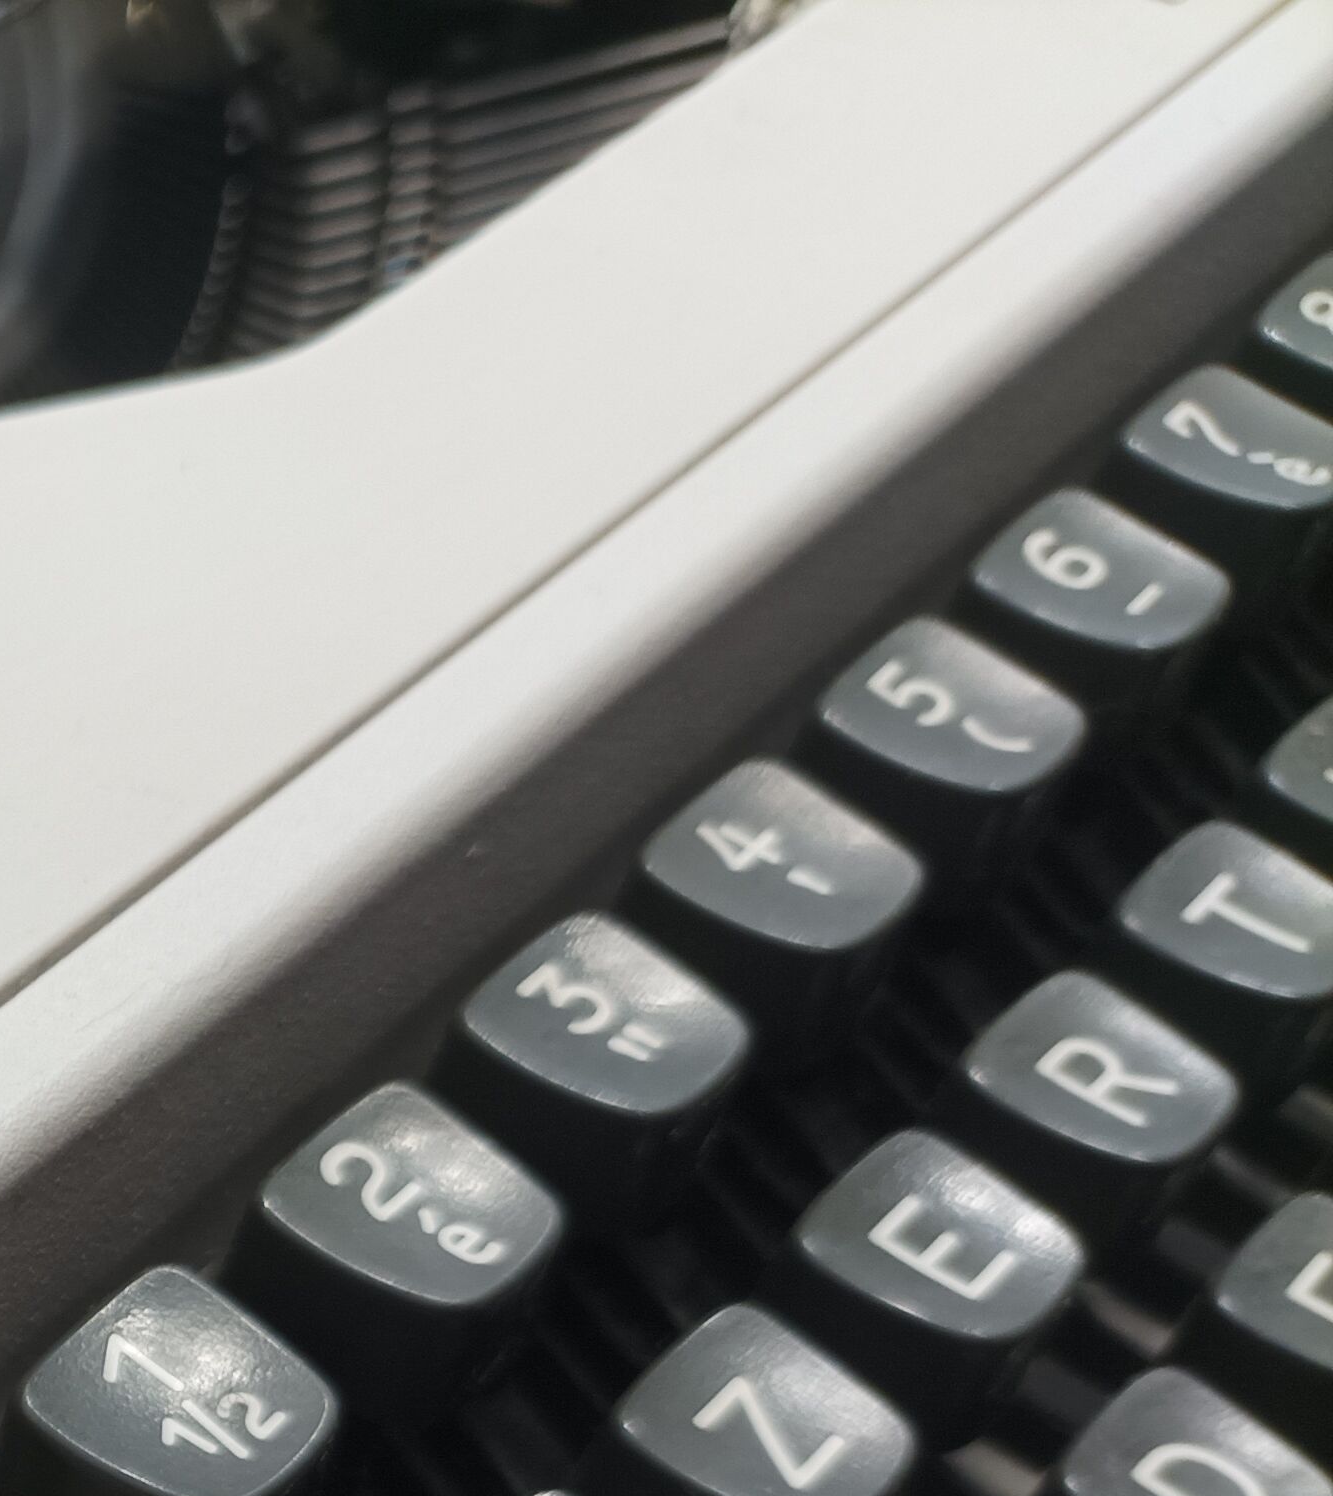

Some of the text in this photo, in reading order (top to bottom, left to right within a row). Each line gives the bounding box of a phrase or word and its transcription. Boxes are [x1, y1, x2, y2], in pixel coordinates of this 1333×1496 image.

[1162, 401, 1241, 457] 7
[1021, 528, 1109, 590] 6
[865, 659, 957, 727] 5
[695, 821, 783, 872] 4
[1180, 871, 1311, 954] T
[515, 961, 619, 1035] 3
[1034, 1036, 1180, 1128] R
[319, 1141, 425, 1222] 2
[867, 1194, 1017, 1300] E
[102, 1332, 185, 1393] 1
[691, 1375, 847, 1490] Z
